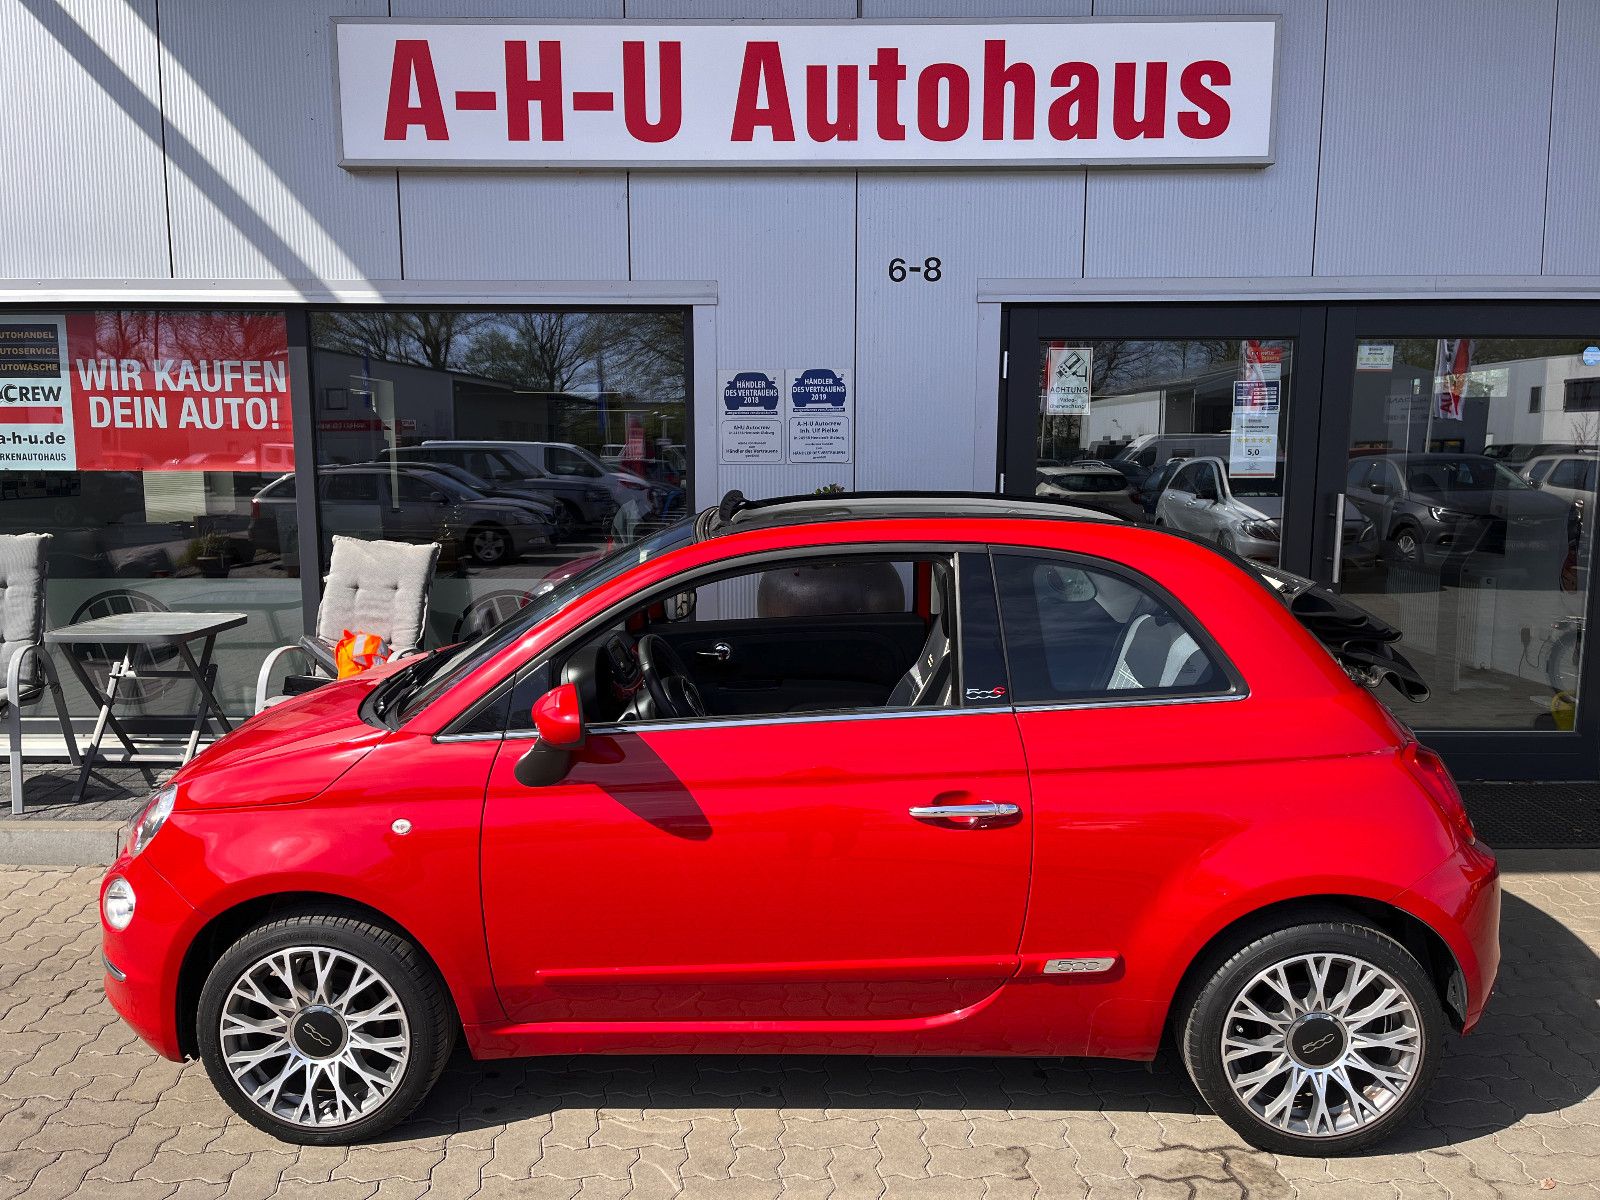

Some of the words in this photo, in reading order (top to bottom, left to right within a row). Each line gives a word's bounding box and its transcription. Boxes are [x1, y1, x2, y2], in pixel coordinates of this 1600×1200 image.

[384, 40, 682, 143] A-H-U
[730, 40, 1232, 142] Autohaus
[888, 257, 942, 282] 6-8
[0, 347, 58, 355] UTOSERVICE
[0, 363, 58, 371] UTOWÄSCHE
[76, 359, 143, 391] WIR
[154, 360, 287, 392] KAUFEN
[736, 380, 766, 389] HÄNDLER
[805, 385, 845, 393] VERTRAUENS
[0, 384, 62, 402] CREW
[725, 389, 737, 397] DES
[738, 389, 778, 397] VERTRAUENS
[811, 393, 827, 401] 2019
[743, 396, 760, 404] 2018
[89, 397, 168, 429] DEIN
[178, 397, 279, 430] AUTO!
[1247, 448, 1260, 457] 5,0
